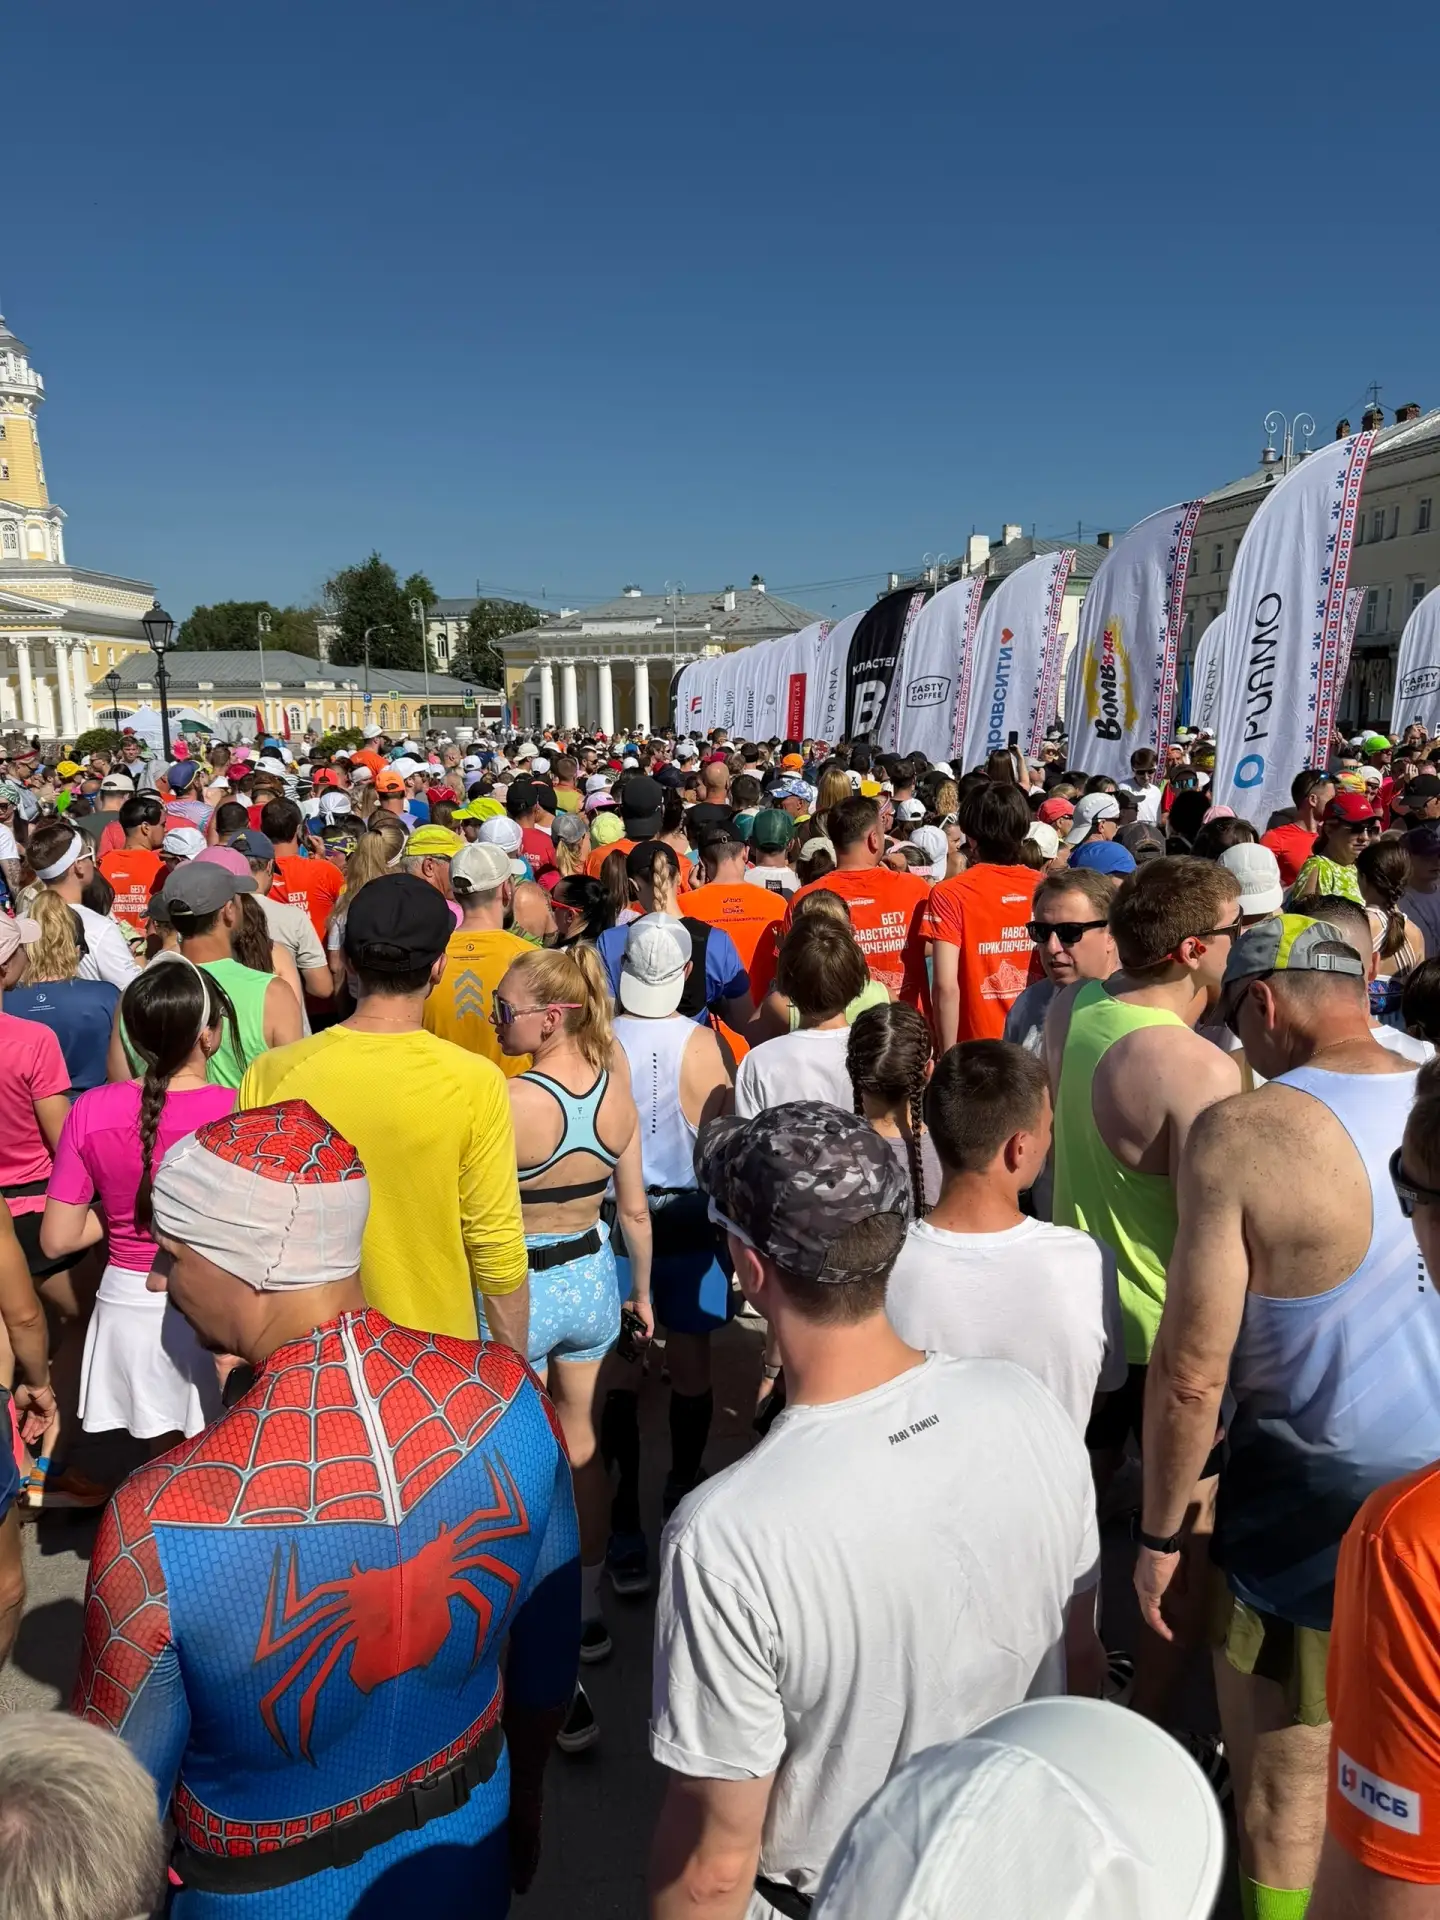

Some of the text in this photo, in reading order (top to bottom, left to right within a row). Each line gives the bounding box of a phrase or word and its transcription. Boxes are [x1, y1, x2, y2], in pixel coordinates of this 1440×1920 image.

[852, 657, 896, 675] КЛАСТЕ
[1403, 672, 1438, 686] TASTY
[911, 682, 944, 694] TASTY
[1404, 681, 1437, 693] COFFEE
[911, 691, 942, 701] COFFEE
[986, 647, 1013, 757] дравсити
[825, 667, 839, 742] LEVRANA
[792, 700, 801, 737] NUTRINO
[288, 891, 307, 902] БЕГУ
[881, 911, 905, 925] БЕГУ
[1002, 926, 1030, 939] НАВСТ
[888, 1413, 940, 1446] PARI FAMILY
[1361, 1780, 1408, 1818] ПСБ
